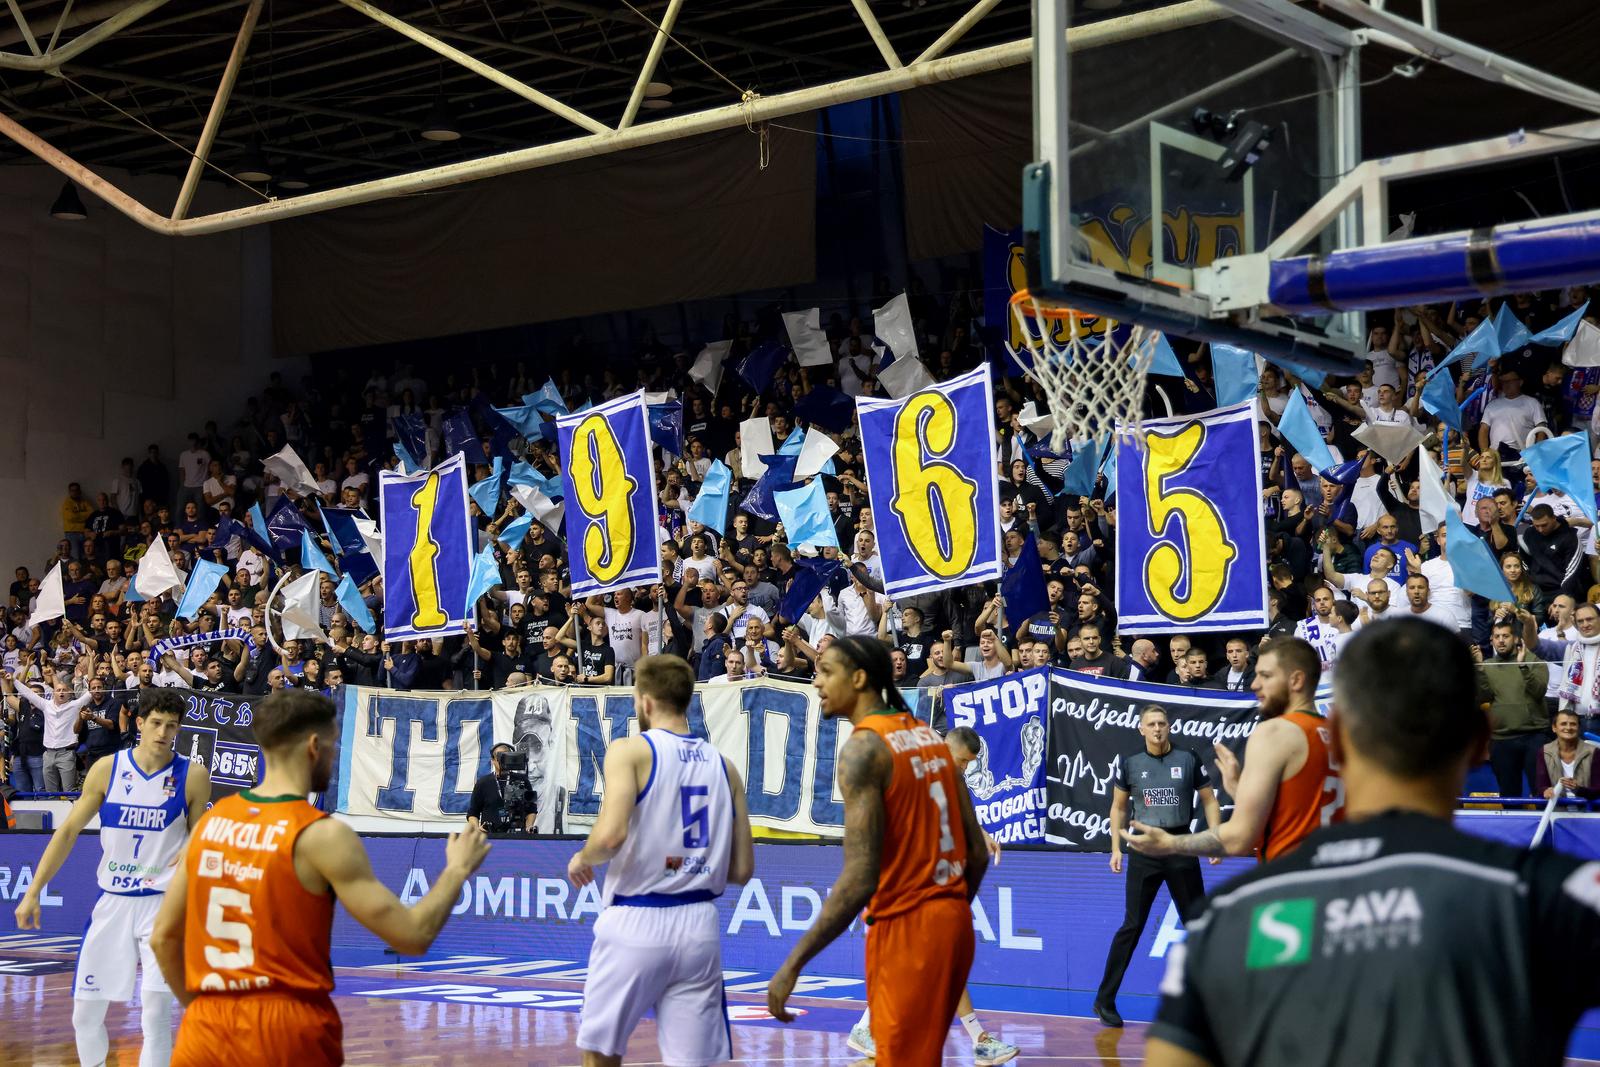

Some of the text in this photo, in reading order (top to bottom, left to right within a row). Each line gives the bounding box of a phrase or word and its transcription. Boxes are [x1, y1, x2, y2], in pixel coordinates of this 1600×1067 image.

[567, 412, 638, 585] 9
[891, 390, 978, 580] 6
[410, 470, 449, 631] 1
[1142, 419, 1237, 624] 5
[952, 672, 1046, 730] STOP
[677, 749, 709, 762] WAHL
[118, 806, 167, 829] ZADAR
[681, 785, 709, 849] 5
[1143, 788, 1175, 798] FASHION
[132, 834, 144, 859] 7
[206, 886, 254, 969] 5
[1325, 887, 1422, 932] SAVA
